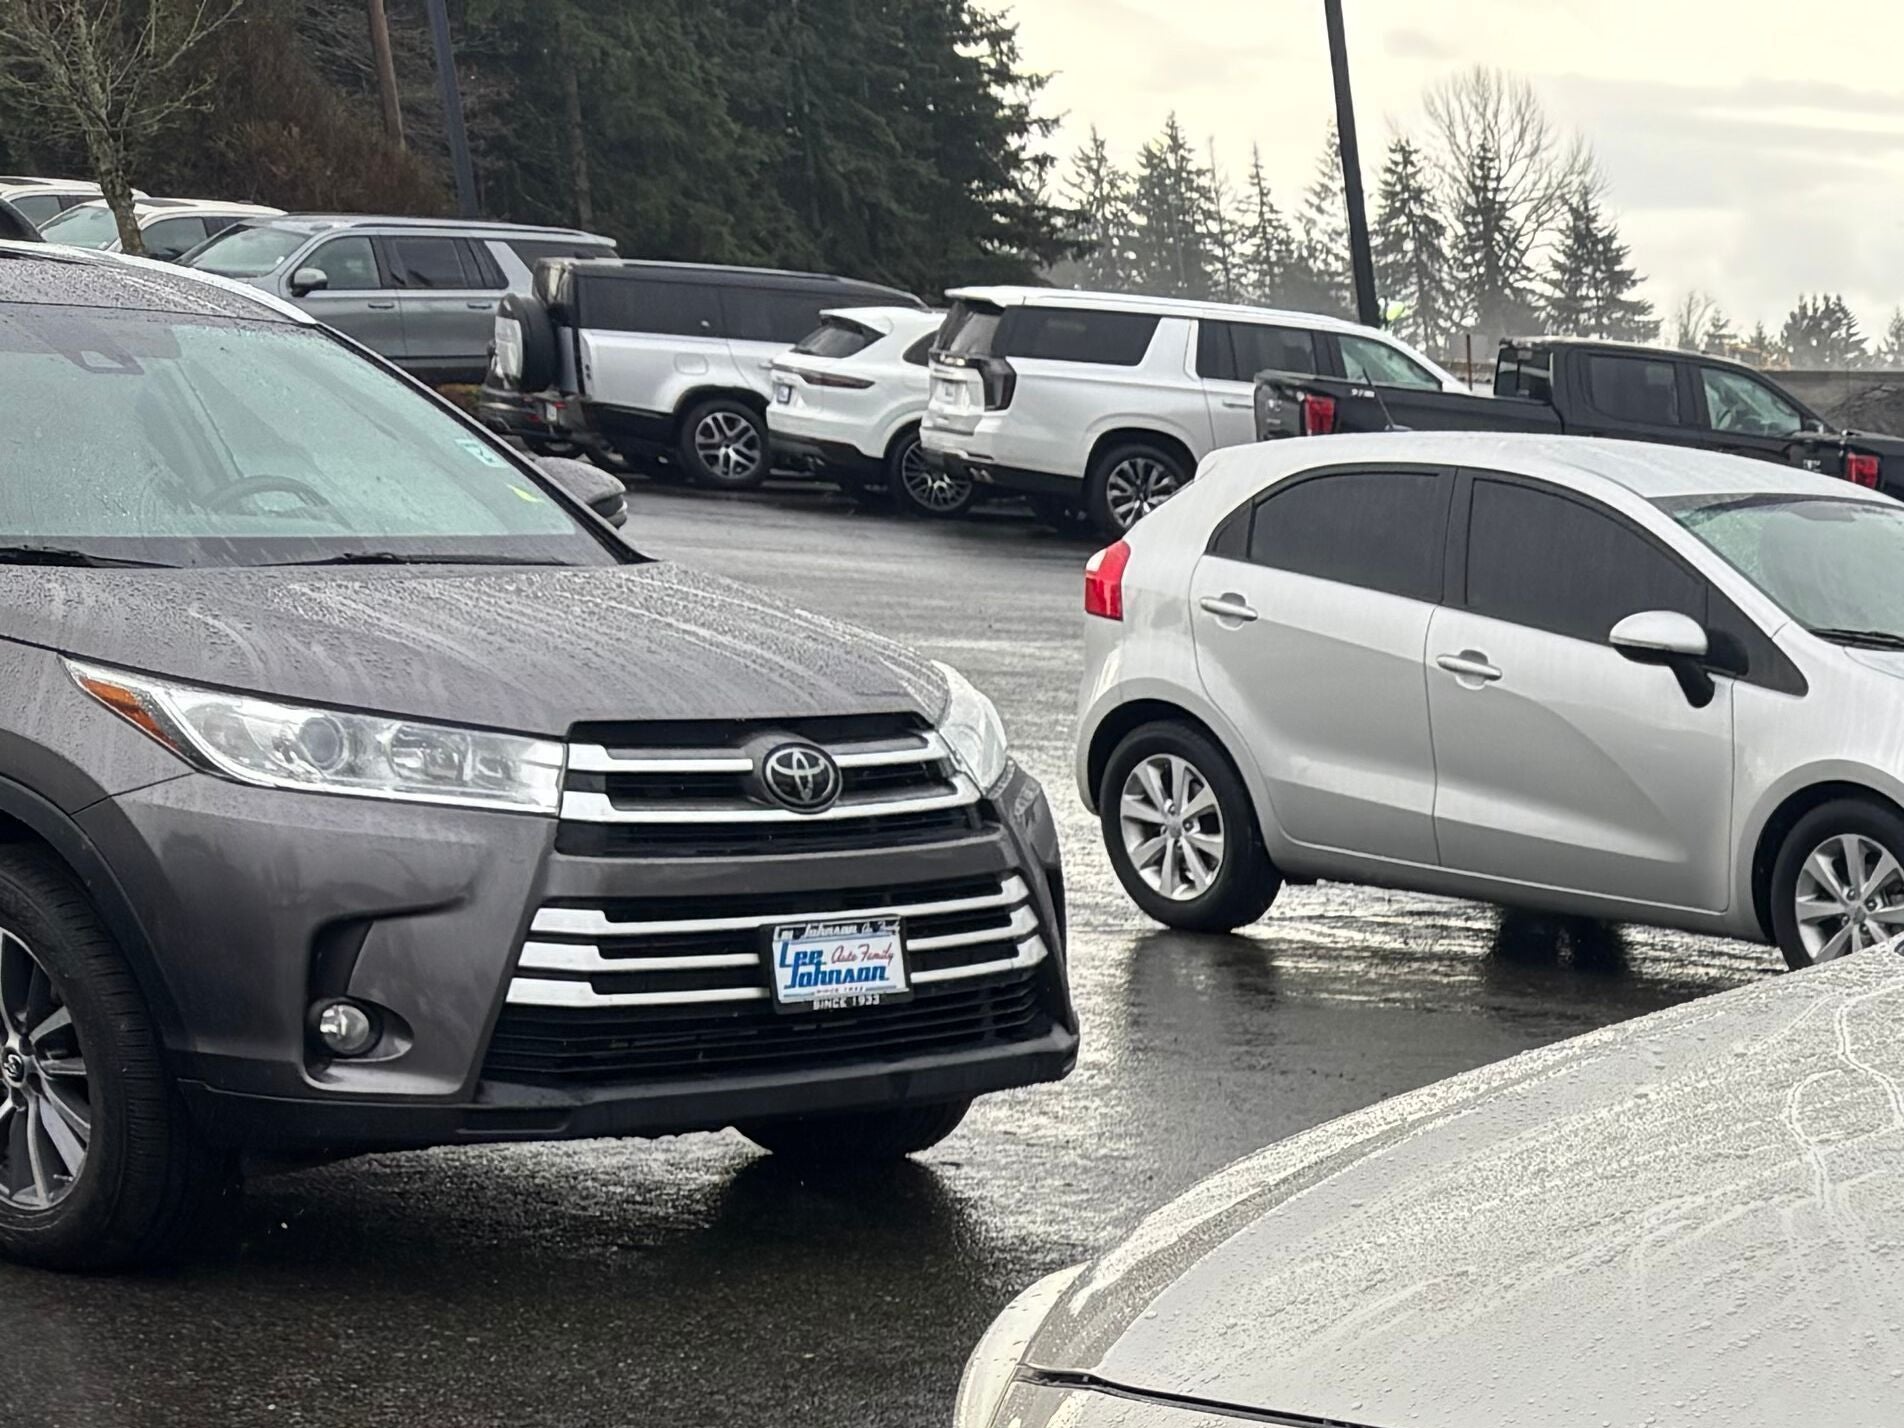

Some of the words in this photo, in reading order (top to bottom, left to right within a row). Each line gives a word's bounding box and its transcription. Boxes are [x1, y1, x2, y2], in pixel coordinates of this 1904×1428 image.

[779, 941, 827, 968] Lee
[831, 945, 858, 963] Auto
[858, 942, 895, 966] Family
[784, 957, 890, 989] Johnson
[812, 996, 848, 1011] SINCE
[852, 994, 880, 1007] 1933
